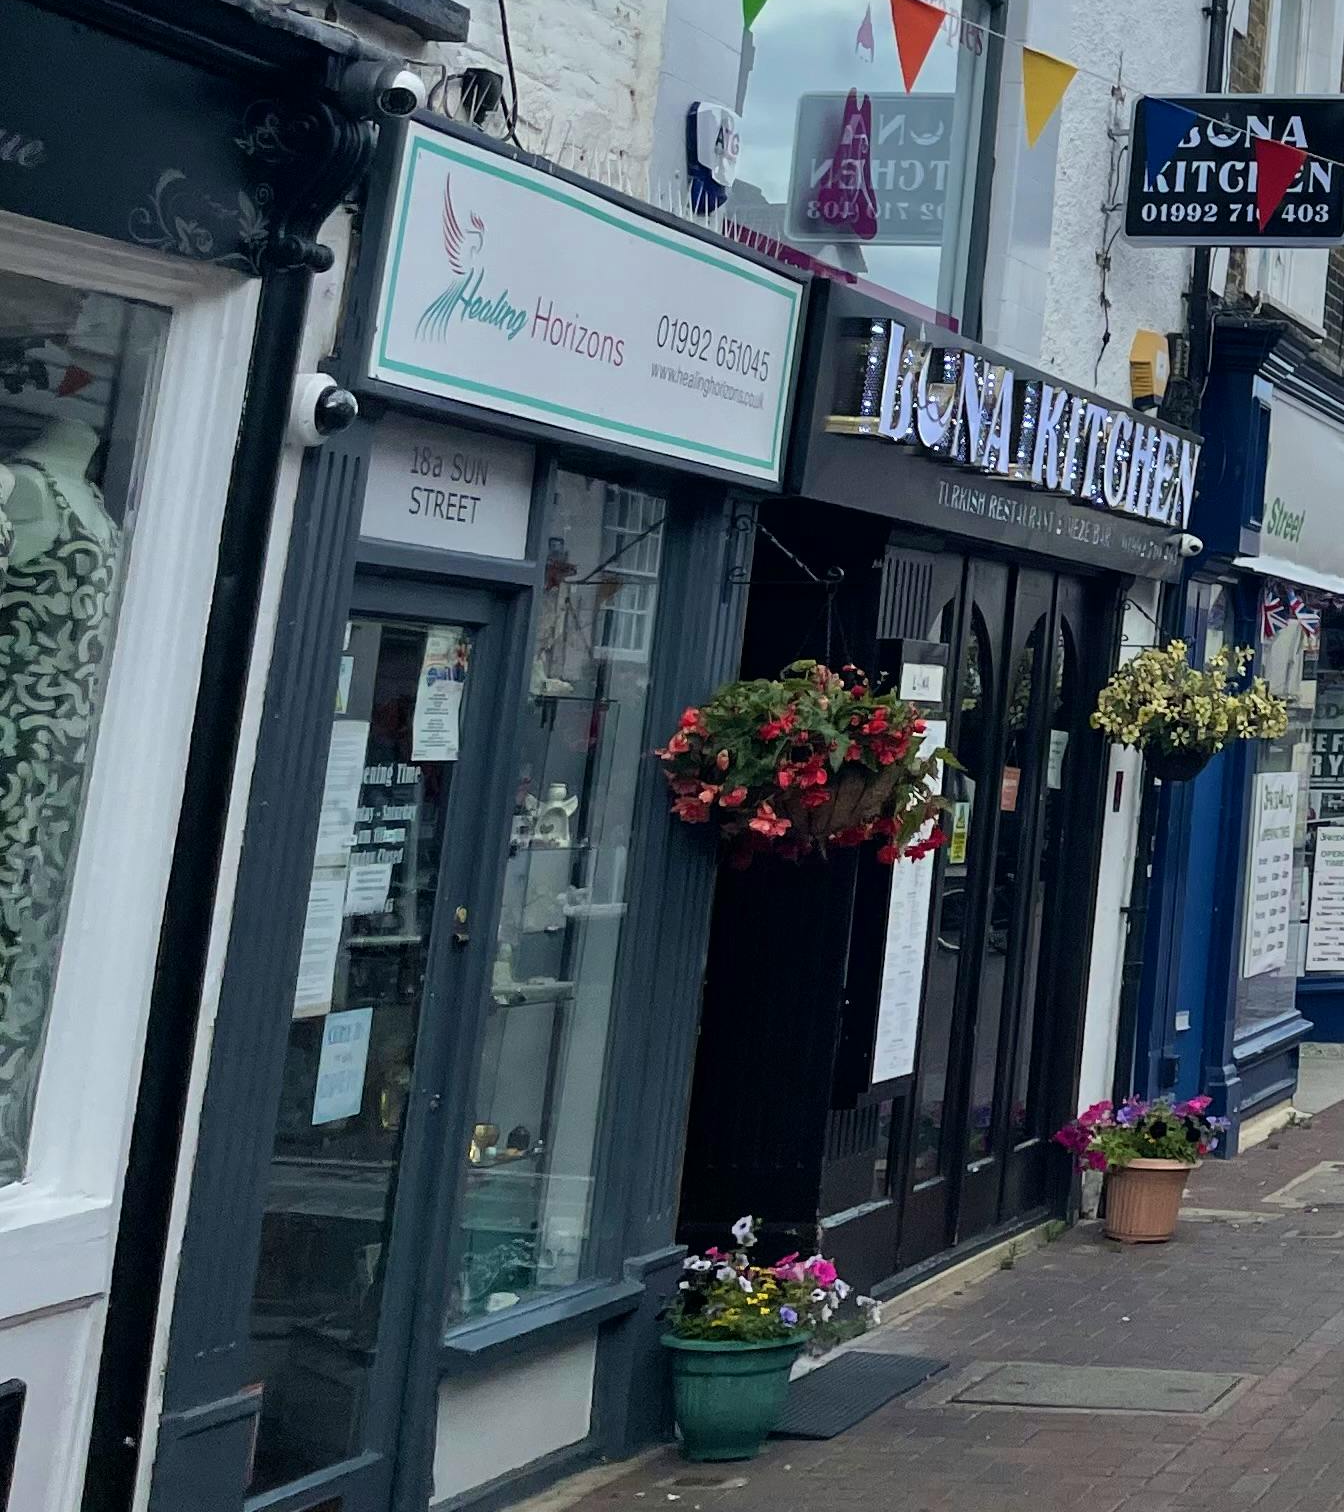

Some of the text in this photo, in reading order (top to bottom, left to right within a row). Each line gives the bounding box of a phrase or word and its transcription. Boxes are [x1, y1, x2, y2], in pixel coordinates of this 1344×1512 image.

[1141, 202, 1330, 223] 01992 71 403
[455, 267, 626, 367] Healing Horizons
[656, 314, 771, 382] 01992 651045
[410, 445, 489, 487] 18a SUN
[1031, 380, 1202, 530] KITCHEN
[408, 486, 482, 525] STREET
[937, 480, 986, 516] TURKISH
[1267, 496, 1306, 544] Street
